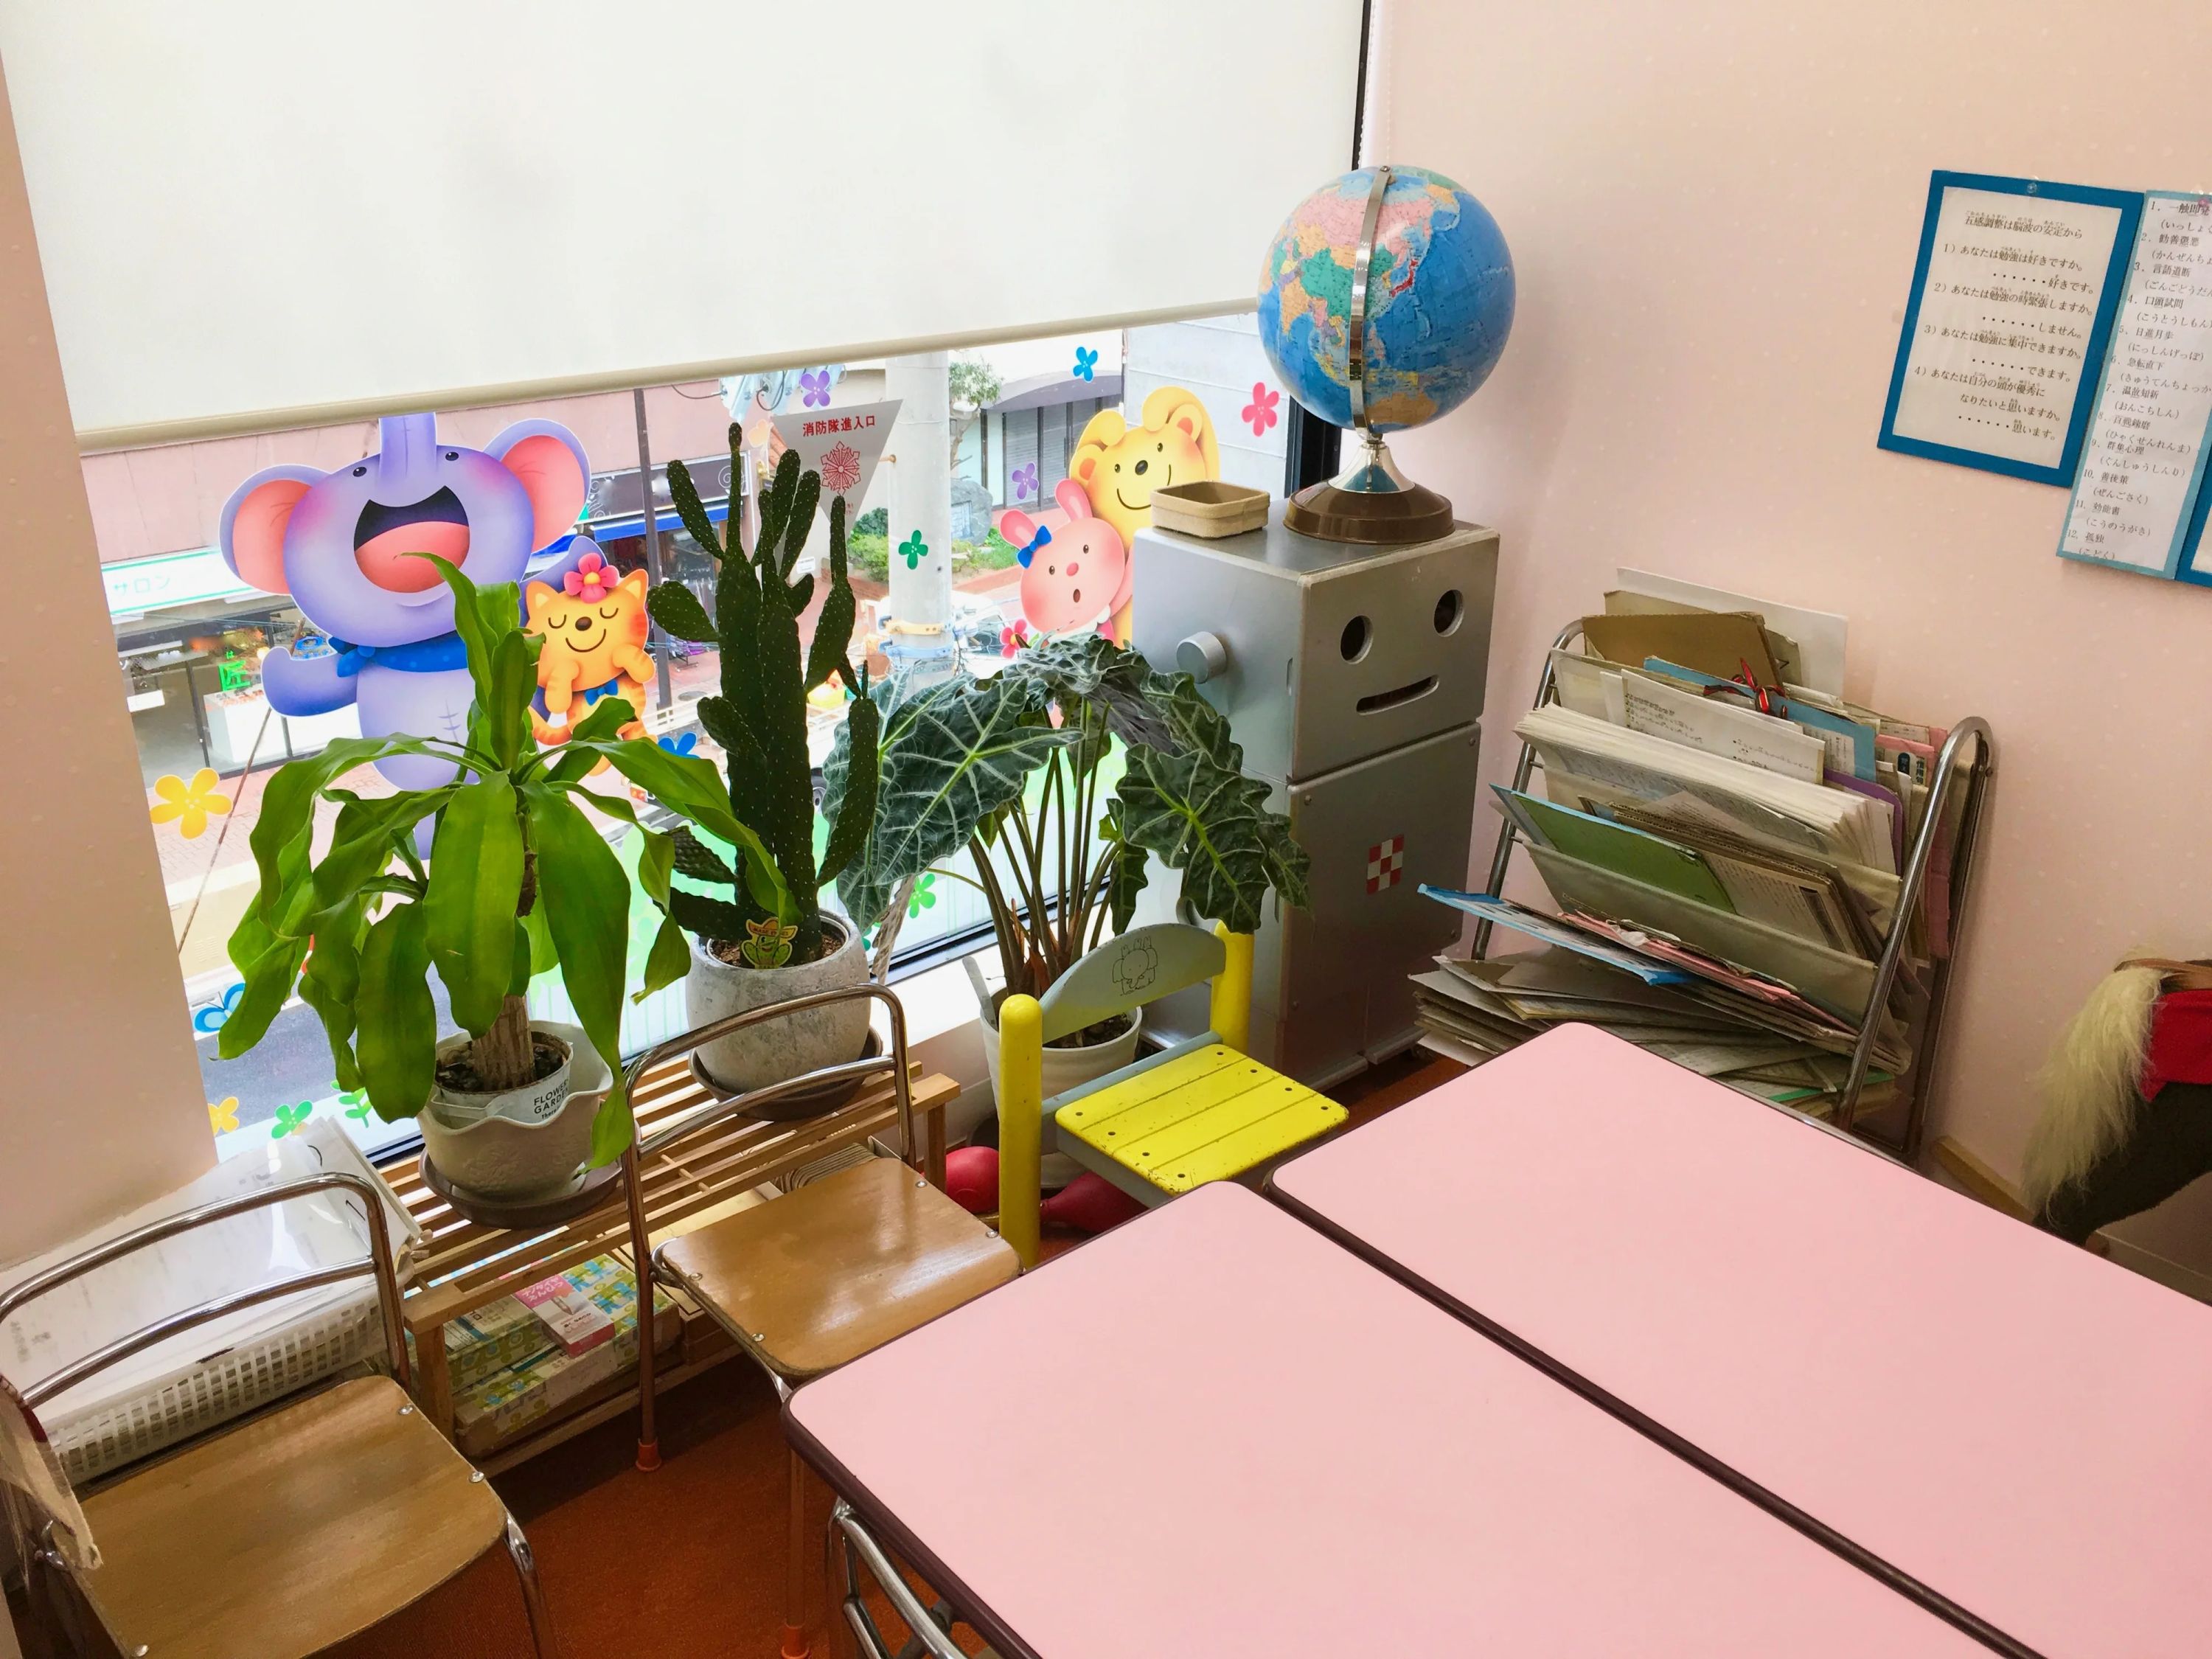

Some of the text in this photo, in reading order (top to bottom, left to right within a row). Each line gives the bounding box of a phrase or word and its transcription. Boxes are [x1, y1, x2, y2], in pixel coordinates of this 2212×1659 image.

[2153, 264, 2190, 277] 言語道断
[2145, 296, 2184, 309] 口頭試問
[2135, 327, 2174, 340] 日進月歩
[2127, 357, 2165, 371] 急転直下
[2122, 385, 2159, 400] 温故知新
[802, 415, 875, 437] 消防隊進入口
[2107, 441, 2145, 455] 群集心理
[2101, 471, 2129, 484] 善後策
[2093, 502, 2121, 515] 効能書
[2085, 532, 2104, 544] 孤独
[114, 574, 171, 597] サロン
[534, 1087, 568, 1114] GARDE
